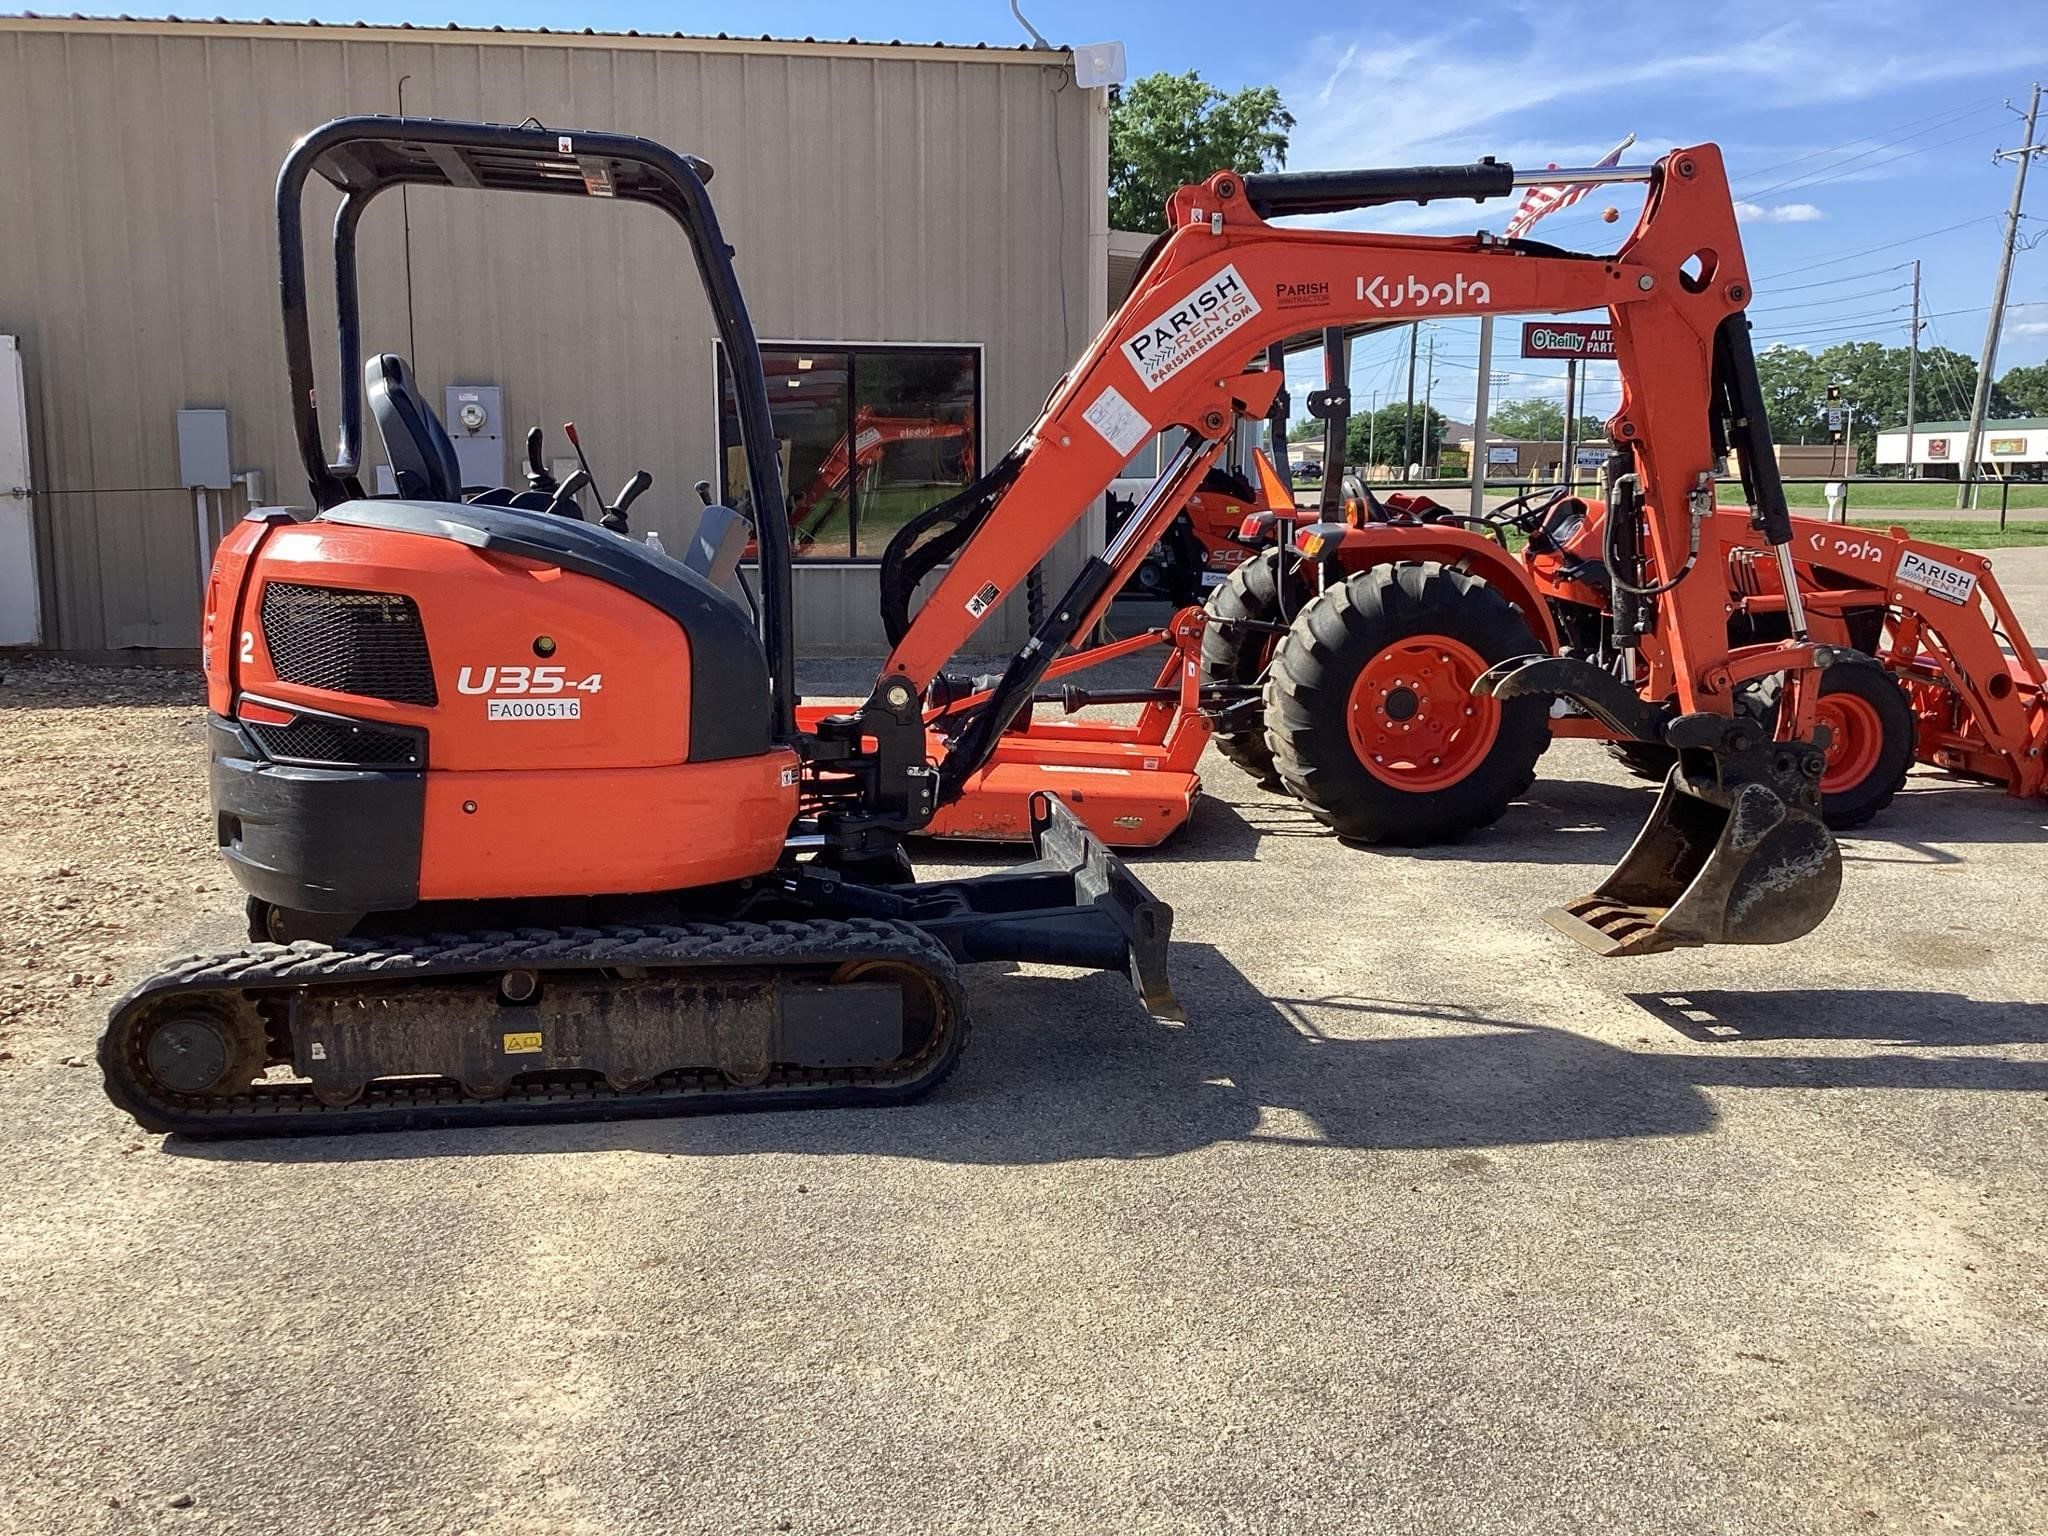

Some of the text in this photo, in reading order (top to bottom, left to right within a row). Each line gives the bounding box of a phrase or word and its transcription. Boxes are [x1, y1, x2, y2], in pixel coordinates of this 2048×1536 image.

[1276, 282, 1329, 297] PARISH
[1356, 272, 1491, 308] Kubota
[1130, 274, 1239, 361] PARISH
[1175, 292, 1246, 348] RENTS
[1151, 305, 1253, 383] PARISHRENTS.COM
[1532, 329, 1586, 352] O'Reilly
[1586, 342, 1617, 353] PART
[1590, 330, 1615, 341] AUT
[1904, 554, 1971, 590] PARISH
[1921, 575, 1967, 597] RENTS
[241, 630, 255, 664] 2
[457, 666, 603, 695] U35-4
[489, 703, 579, 717] FA000516
